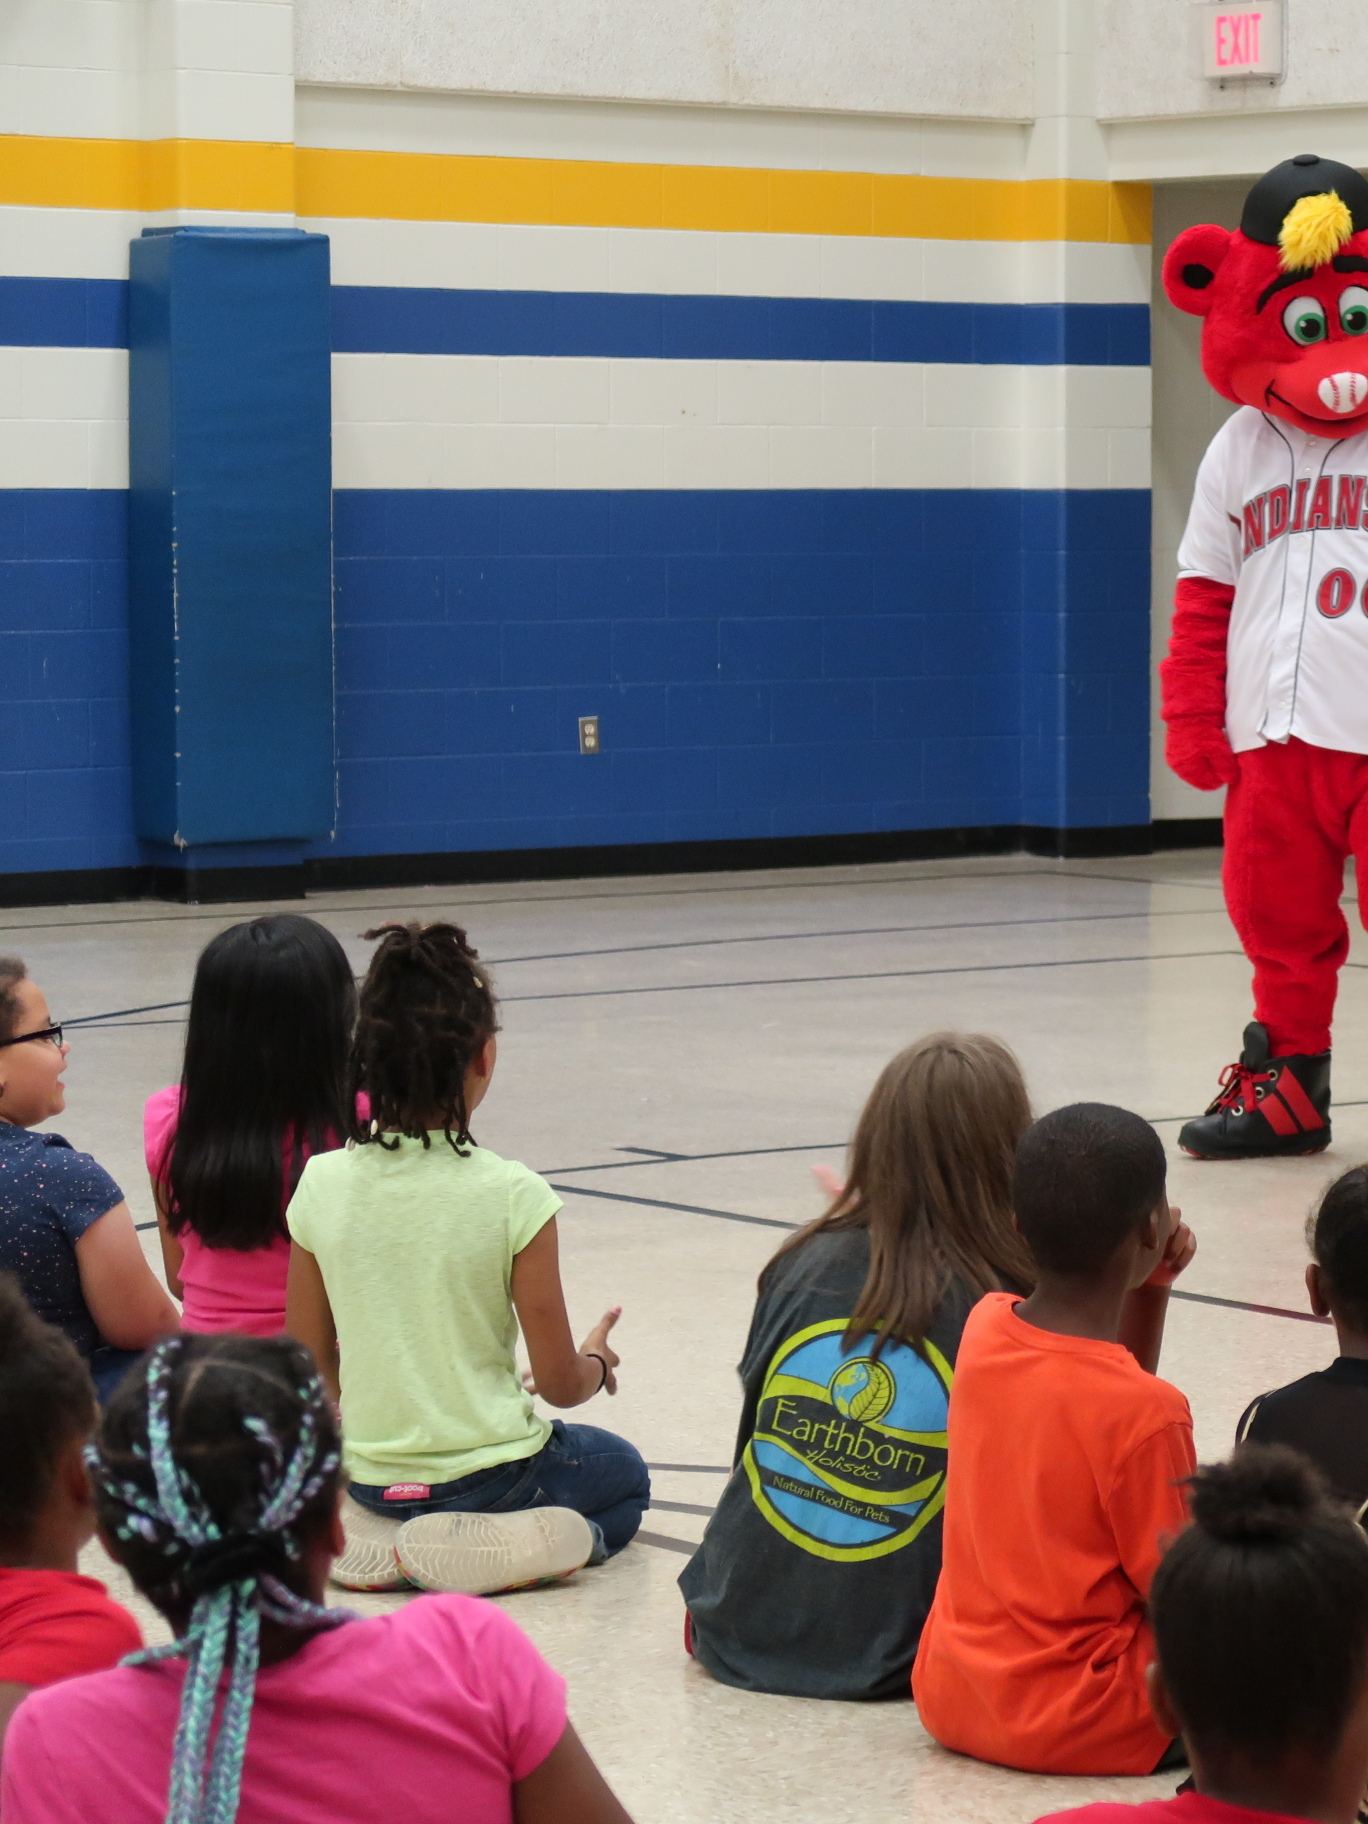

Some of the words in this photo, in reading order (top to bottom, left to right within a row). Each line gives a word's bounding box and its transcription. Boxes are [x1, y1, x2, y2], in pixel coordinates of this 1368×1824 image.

[1215, 13, 1263, 67] EXIT
[771, 1398, 926, 1476] Earthborn
[804, 1449, 879, 1481] Holistic
[772, 1475, 814, 1499] Natural
[815, 1490, 844, 1509] Food
[844, 1500, 864, 1516] For
[865, 1506, 890, 1524] Pets
